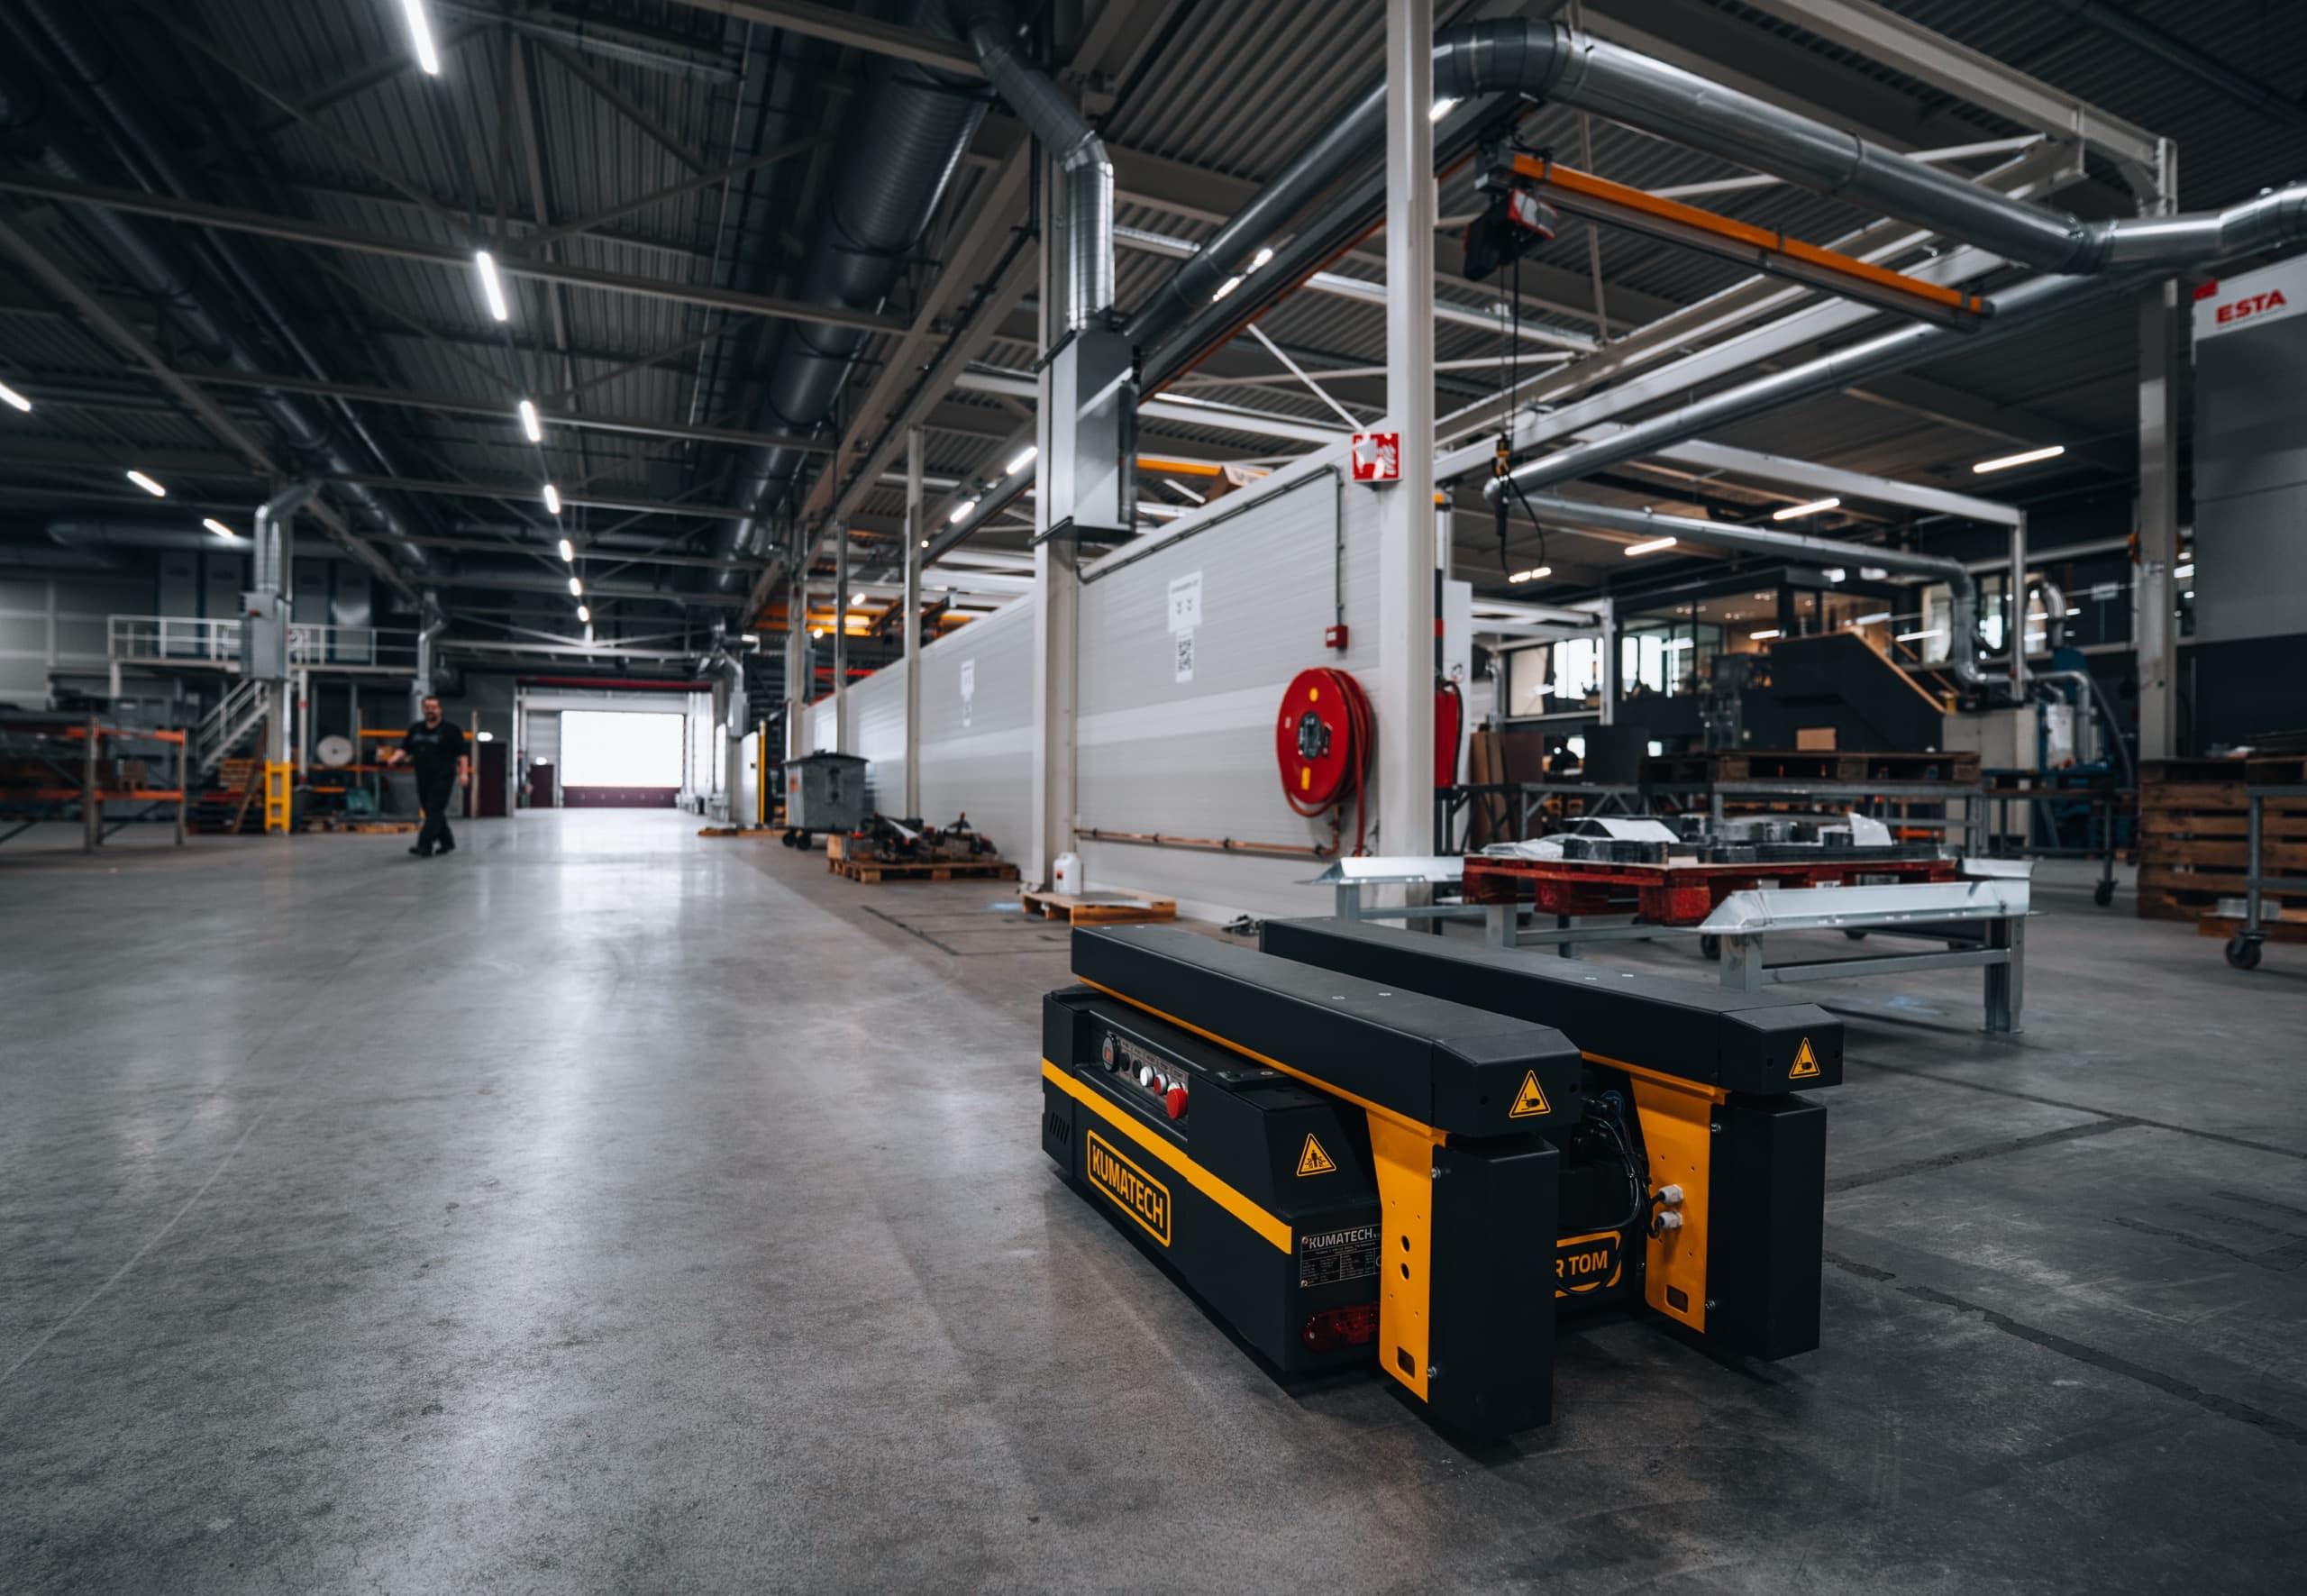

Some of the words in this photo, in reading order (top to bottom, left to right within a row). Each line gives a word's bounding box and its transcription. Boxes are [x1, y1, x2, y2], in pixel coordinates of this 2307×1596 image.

[2216, 289, 2287, 324] ESTA
[1092, 1144, 1163, 1229] KUMATECH
[1309, 1227, 1372, 1249] KUMATECH
[1569, 1250, 1608, 1275] TOM
